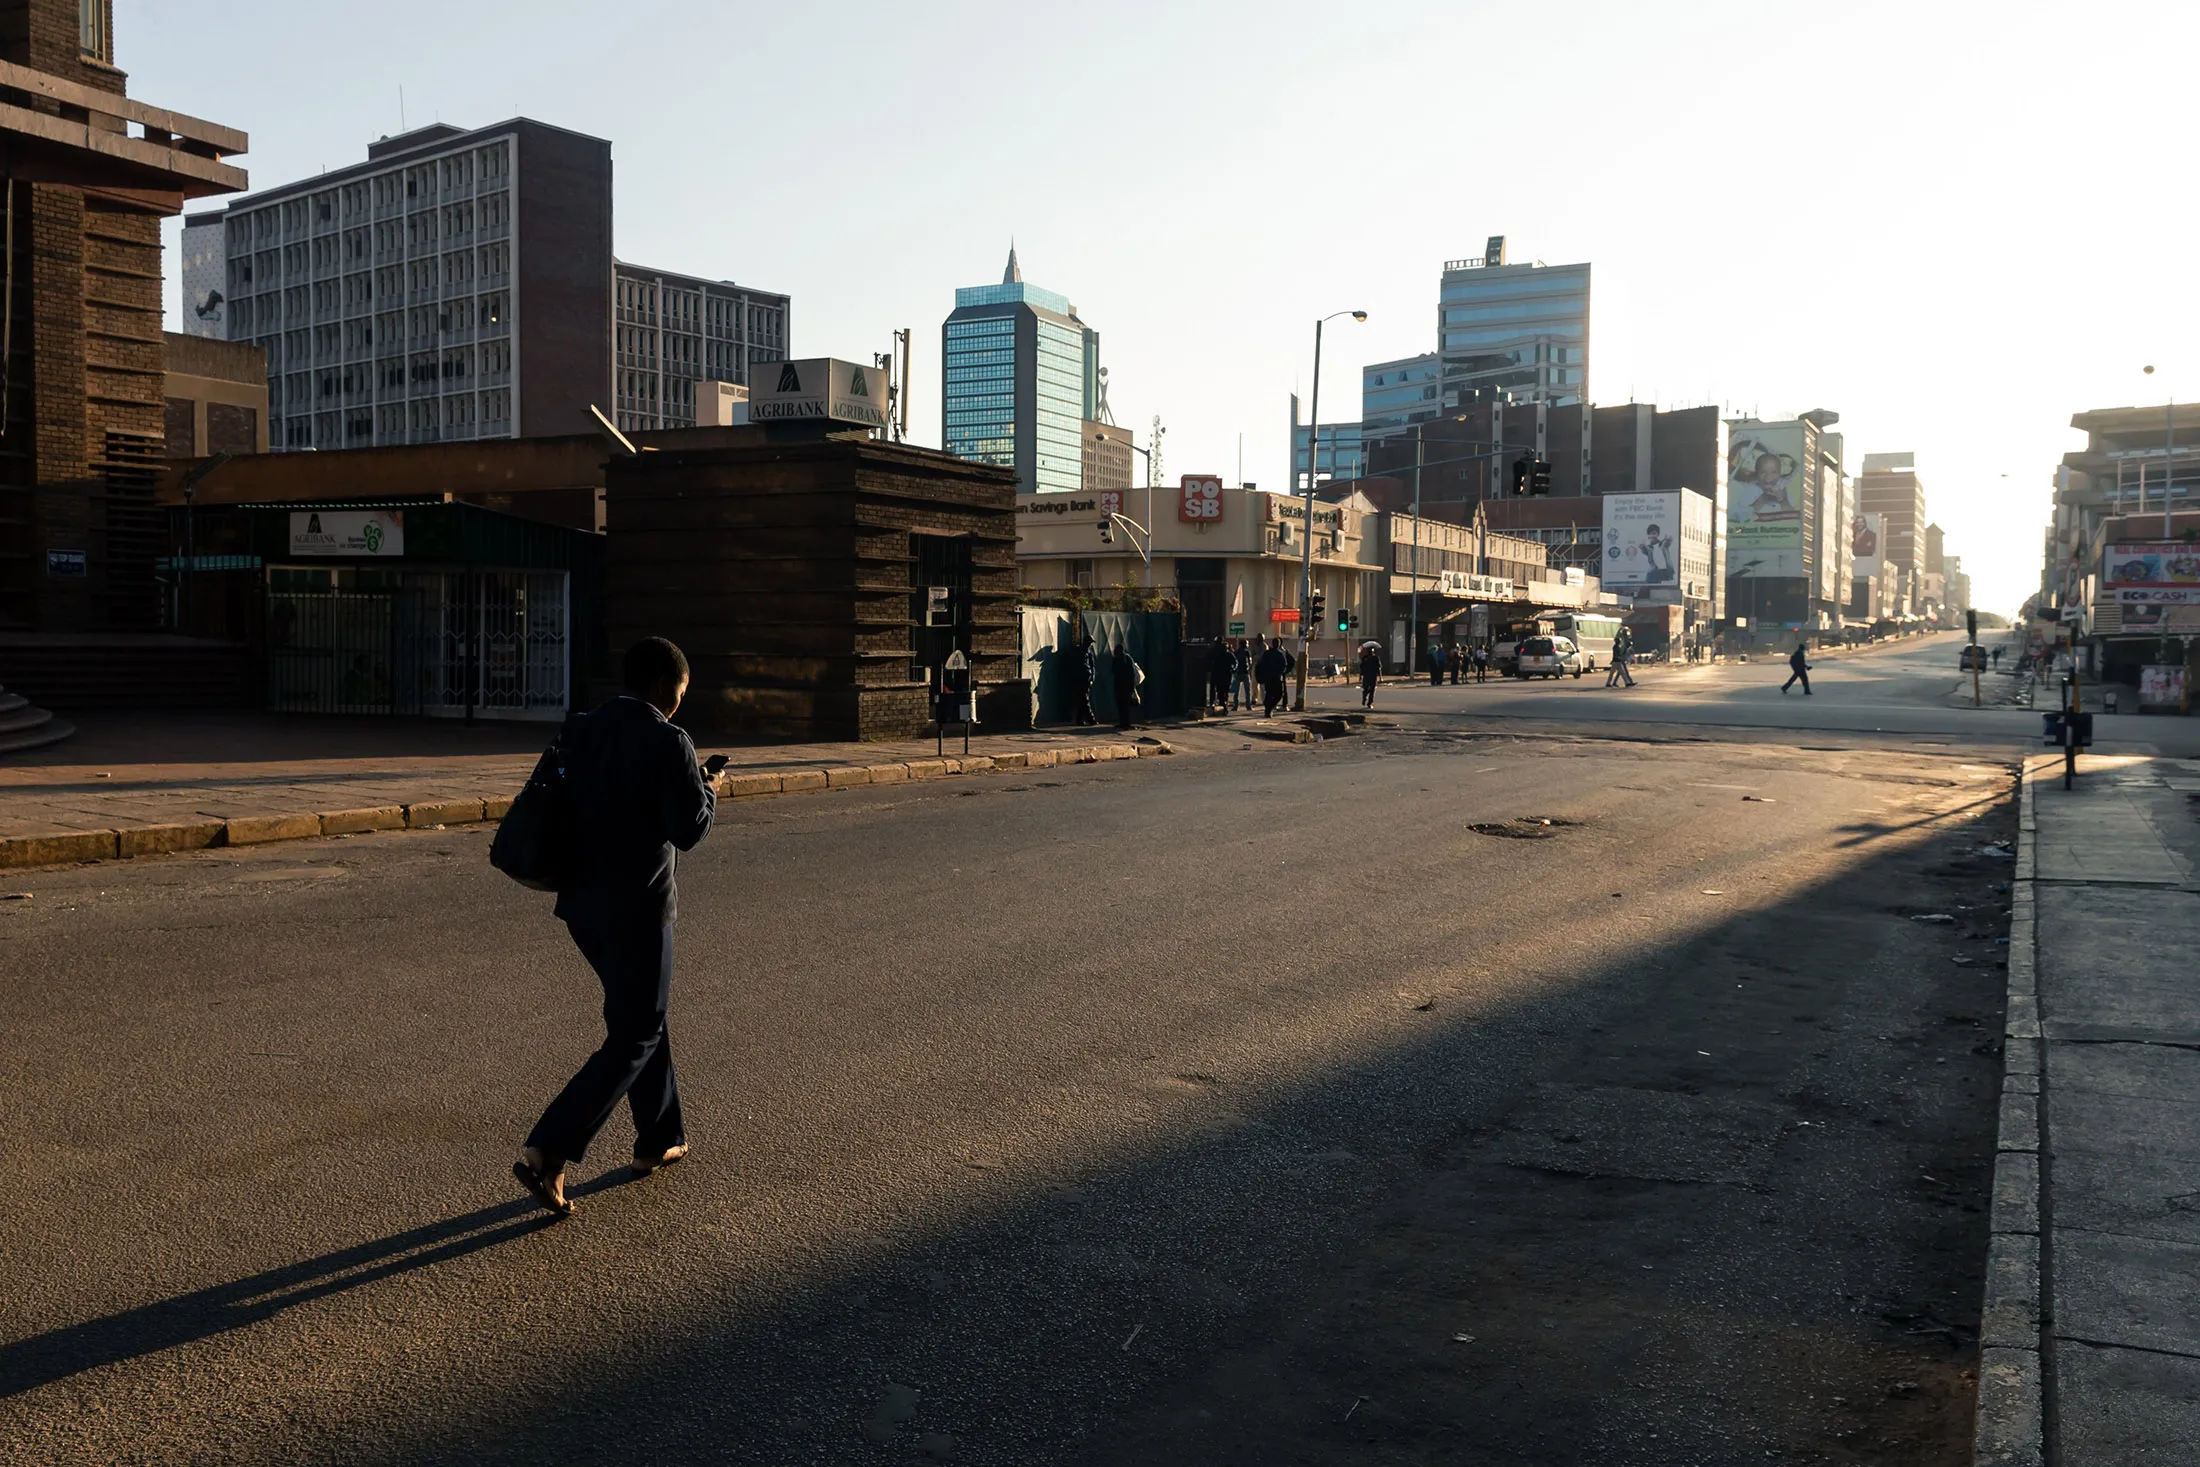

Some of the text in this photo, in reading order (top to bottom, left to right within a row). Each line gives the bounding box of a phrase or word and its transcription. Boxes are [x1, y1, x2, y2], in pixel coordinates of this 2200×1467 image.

[752, 401, 824, 418] AGRIBANK
[832, 404, 885, 424] AGRIBANK
[1184, 480, 1220, 498] PO
[1030, 501, 1068, 516] Savings
[1070, 499, 1096, 511] Bank
[1184, 499, 1220, 518] SB
[295, 535, 337, 544] AGRIBANK
